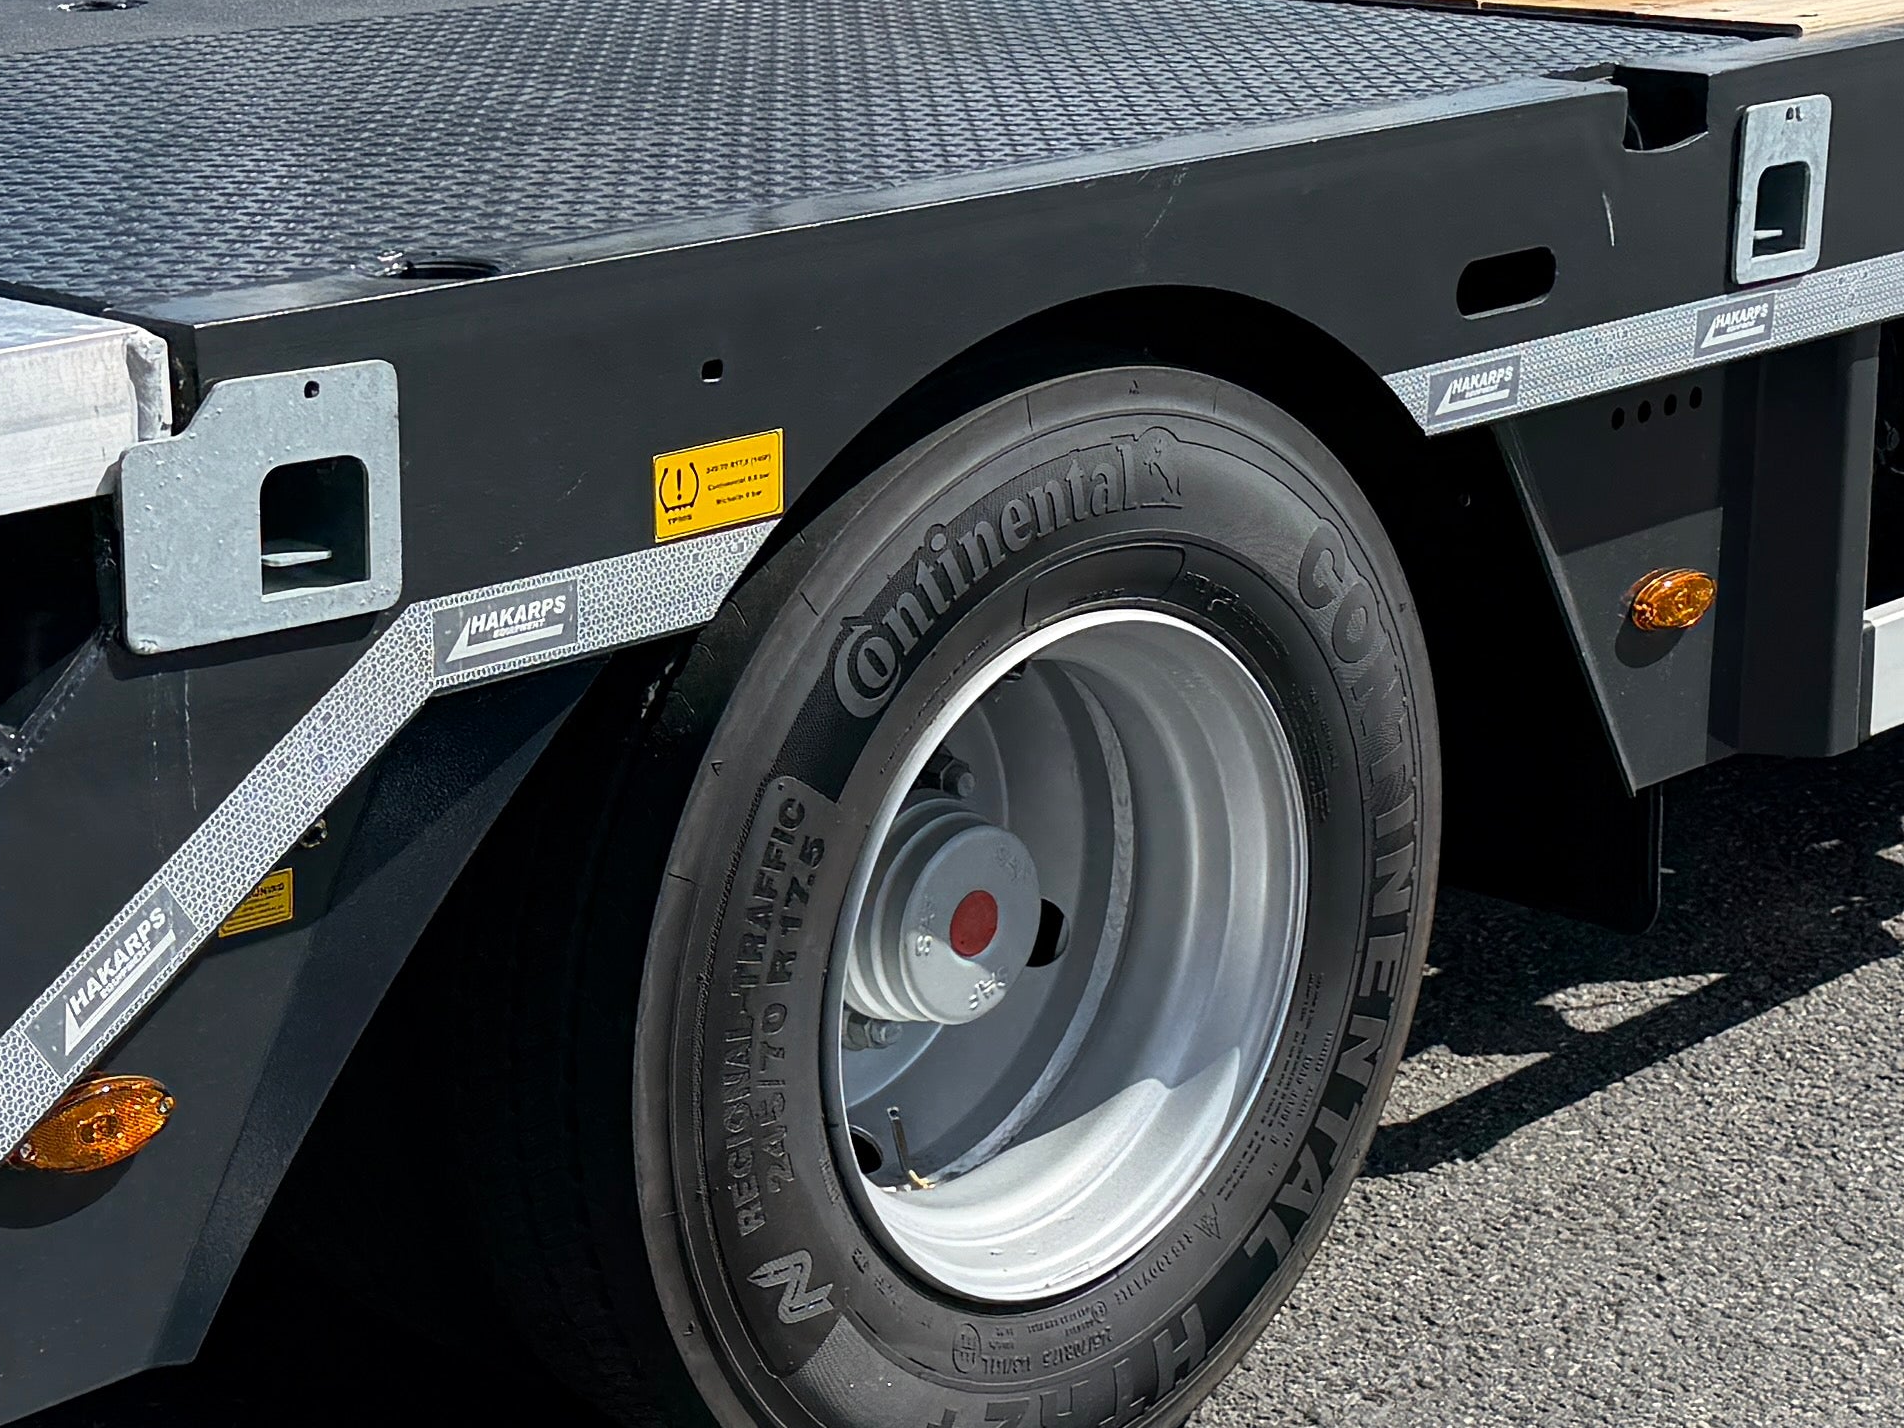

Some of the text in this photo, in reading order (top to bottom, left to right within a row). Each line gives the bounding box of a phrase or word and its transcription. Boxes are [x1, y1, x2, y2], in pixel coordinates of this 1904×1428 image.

[1715, 303, 1768, 329] HAKARPS
[1451, 365, 1513, 395] HAKARPS
[470, 594, 567, 636] HAKARPS
[834, 440, 1138, 720] Continental
[1245, 525, 1419, 1268] CONTINENTAL
[69, 907, 166, 1015] HAKARPS
[754, 1001, 795, 1195] 245/70
[779, 834, 826, 938] 17.5
